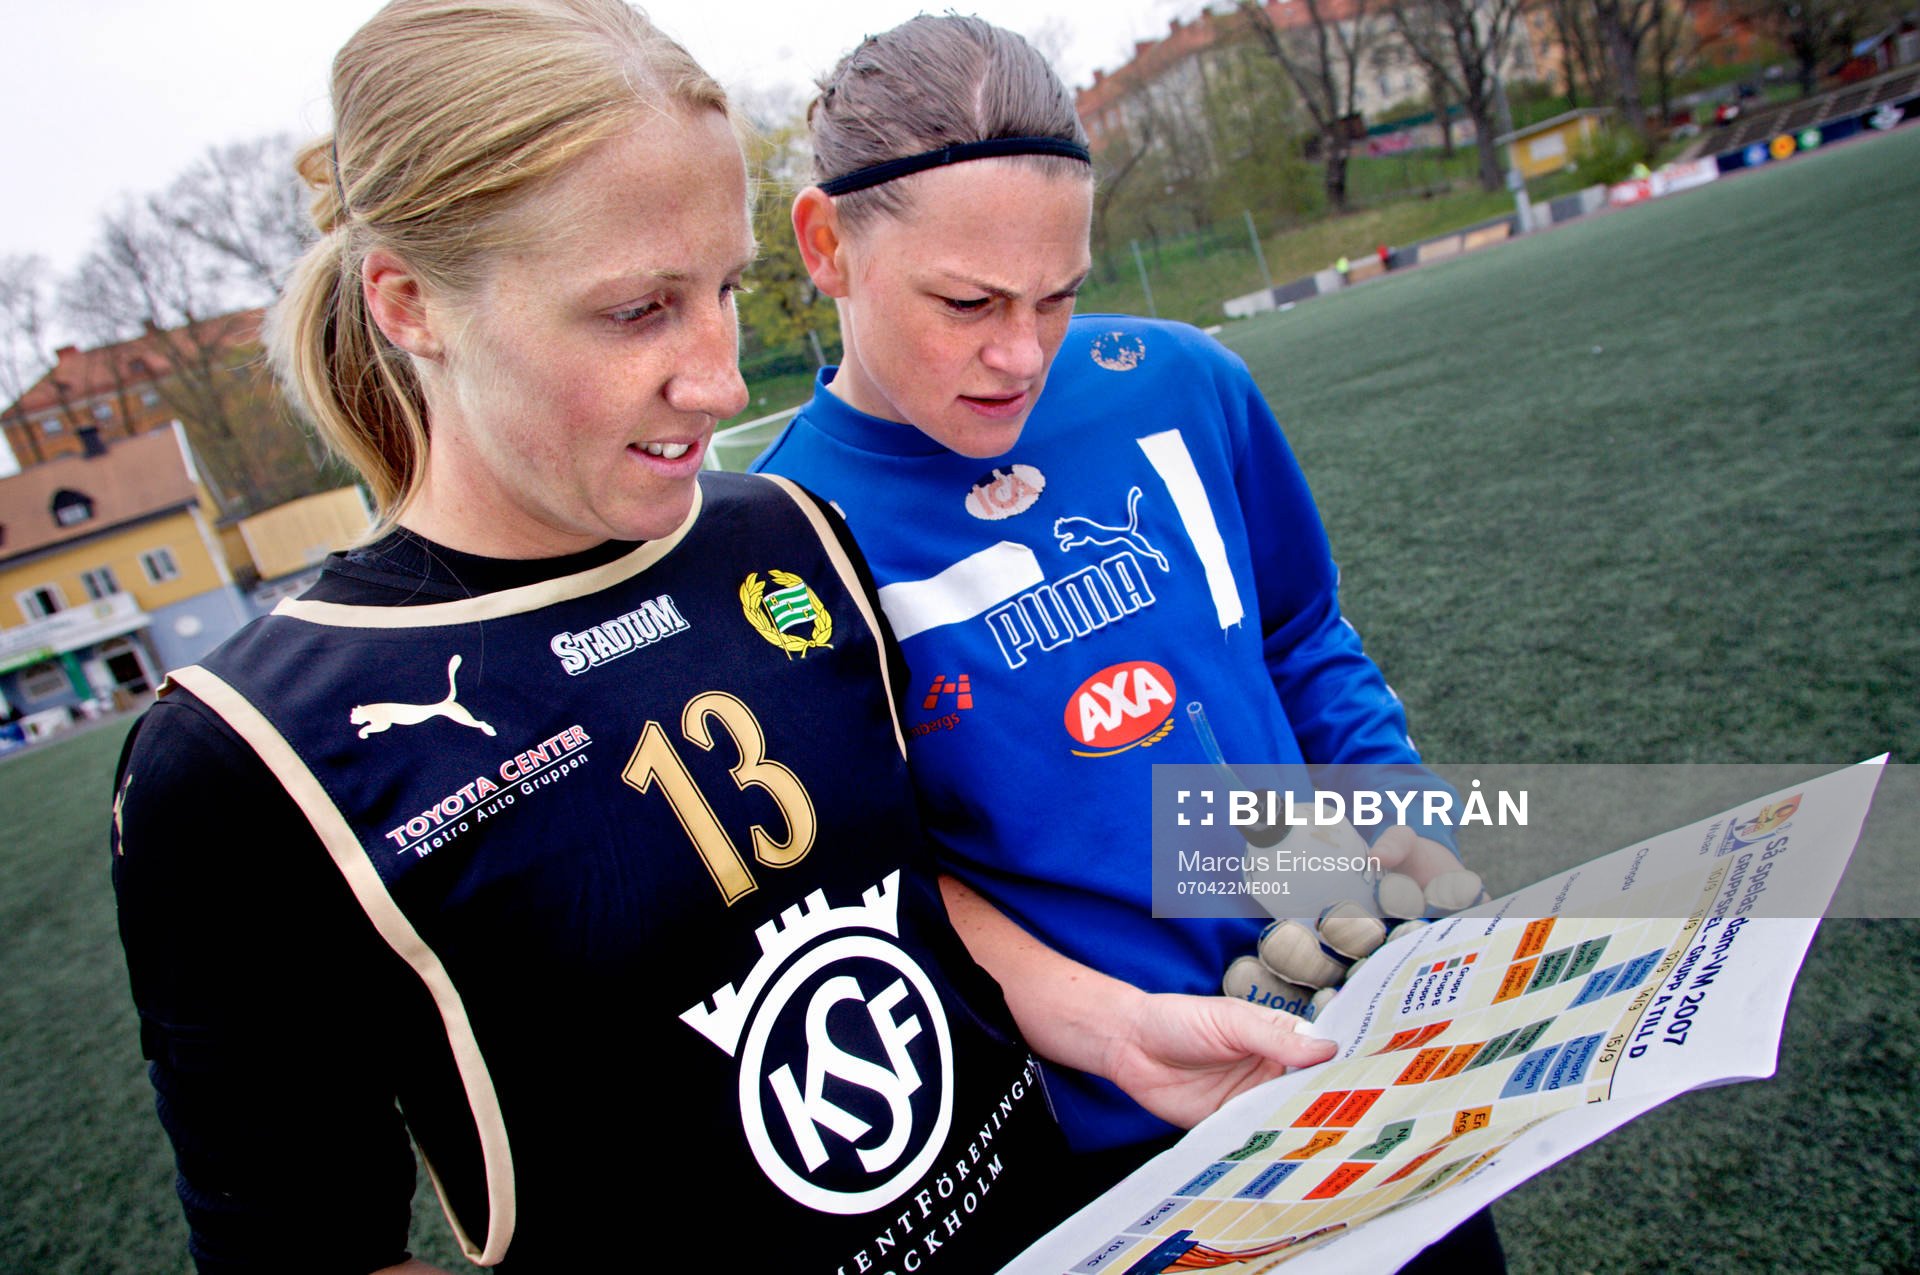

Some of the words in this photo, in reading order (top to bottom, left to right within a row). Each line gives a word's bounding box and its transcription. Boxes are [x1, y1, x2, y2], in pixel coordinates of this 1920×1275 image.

[984, 551, 1156, 670] PUMA
[551, 594, 690, 676] STADIUM
[1079, 667, 1173, 742] AXA
[386, 776, 499, 848] TOYOTA
[499, 724, 591, 782] CENTER
[414, 820, 469, 858] Metro
[476, 792, 515, 823] Auto
[520, 752, 589, 796] Gruppen
[621, 691, 817, 907] 13
[1698, 821, 1721, 853] Wuhan
[1761, 837, 1788, 859] Så
[1703, 853, 1752, 931] GRUPPSPEL
[1735, 863, 1773, 914] spelas
[1667, 945, 1706, 992] GRUPP
[1692, 920, 1748, 987] dam-VM
[1403, 978, 1423, 1007] Grupp
[1418, 975, 1438, 1002] Grupp
[1434, 971, 1454, 998] Grupp
[1447, 992, 1455, 1002] A
[1450, 967, 1469, 994] Grupp
[1627, 987, 1653, 1010] 14/9
[1401, 1005, 1410, 1013] D
[1634, 1006, 1666, 1040] TILL
[1662, 992, 1705, 1046] 2007
[1523, 1048, 1555, 1087] Brasilien
[1566, 1035, 1601, 1081] Danmark
[1597, 1035, 1623, 1062] 15/9
[1629, 1045, 1647, 1058] D
[768, 976, 923, 1173] KSF
[1512, 1060, 1534, 1080] Kina
[1547, 1050, 1579, 1089] Zeeland
[883, 1154, 1004, 1275] CKHOLM
